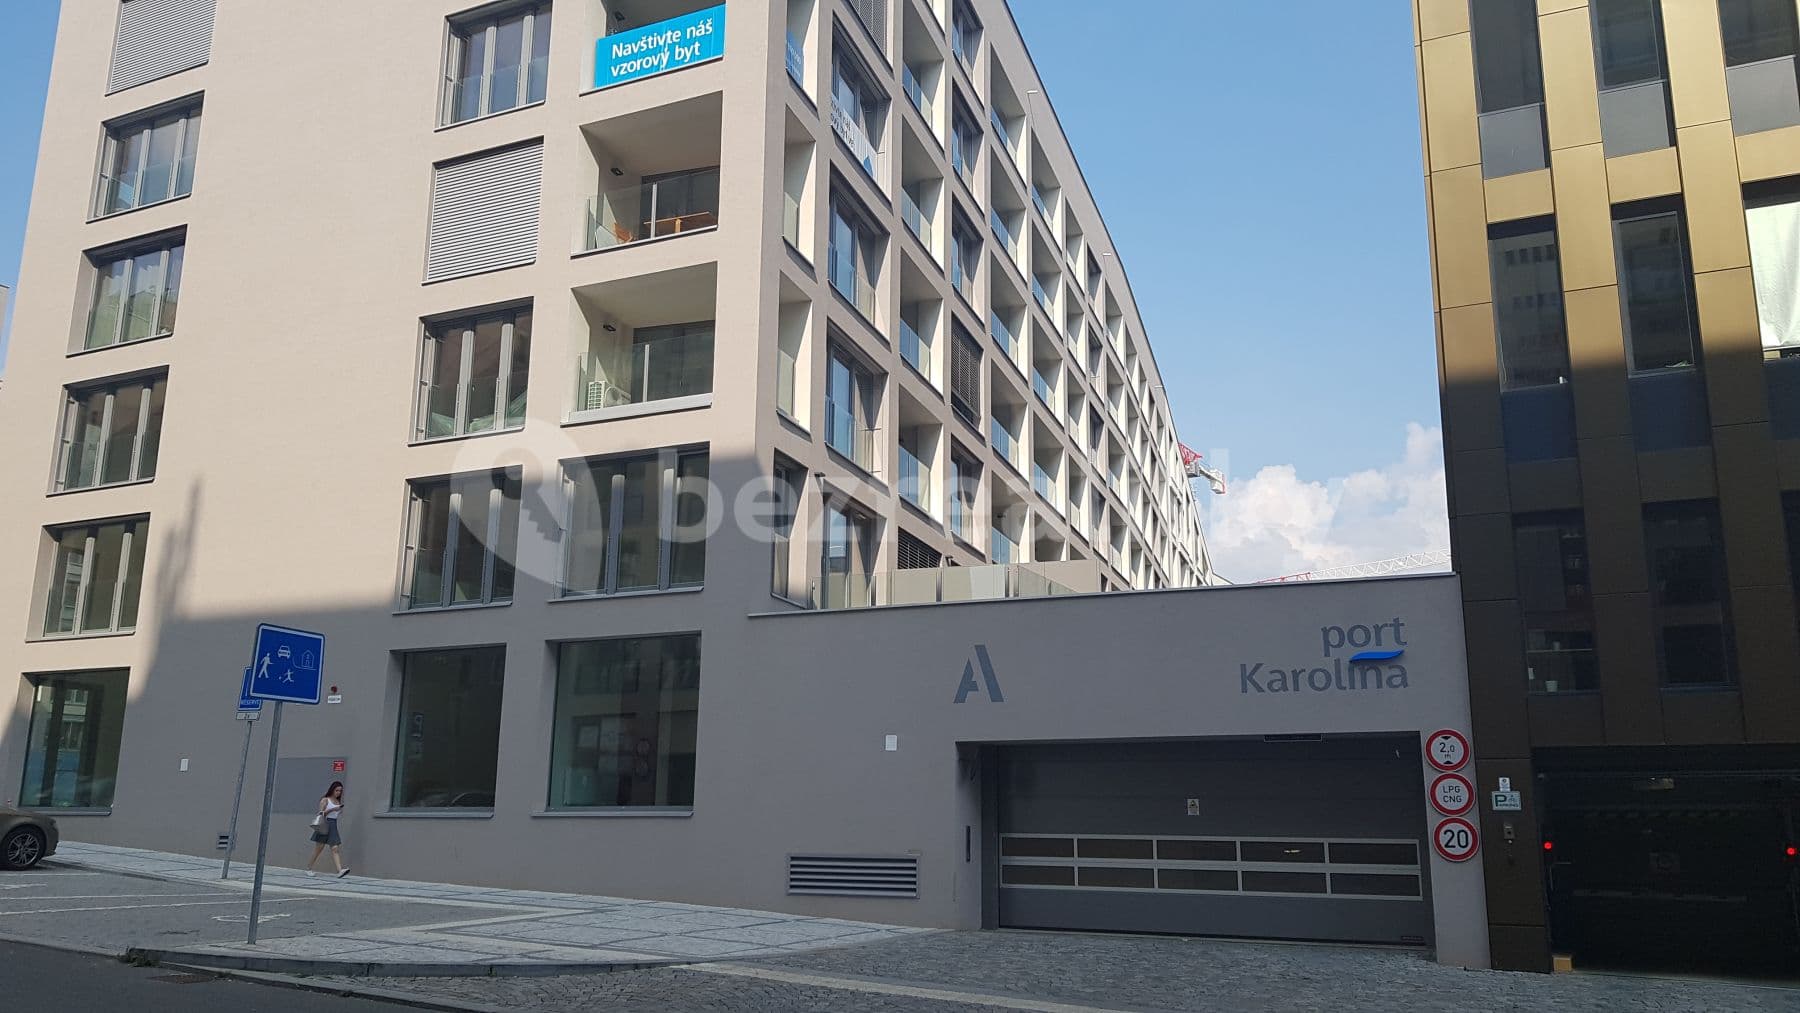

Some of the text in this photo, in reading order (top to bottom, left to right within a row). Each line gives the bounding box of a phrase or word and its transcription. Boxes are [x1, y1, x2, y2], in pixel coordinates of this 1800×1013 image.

[612, 18, 713, 59] Navštivte náš
[610, 41, 701, 77] vzorový byt
[1321, 617, 1407, 657] port
[953, 644, 1005, 704] A
[1240, 658, 1408, 694] Karolina
[1443, 785, 1461, 794] LPG
[1443, 795, 1462, 803] CNG
[1443, 829, 1469, 849] 20
